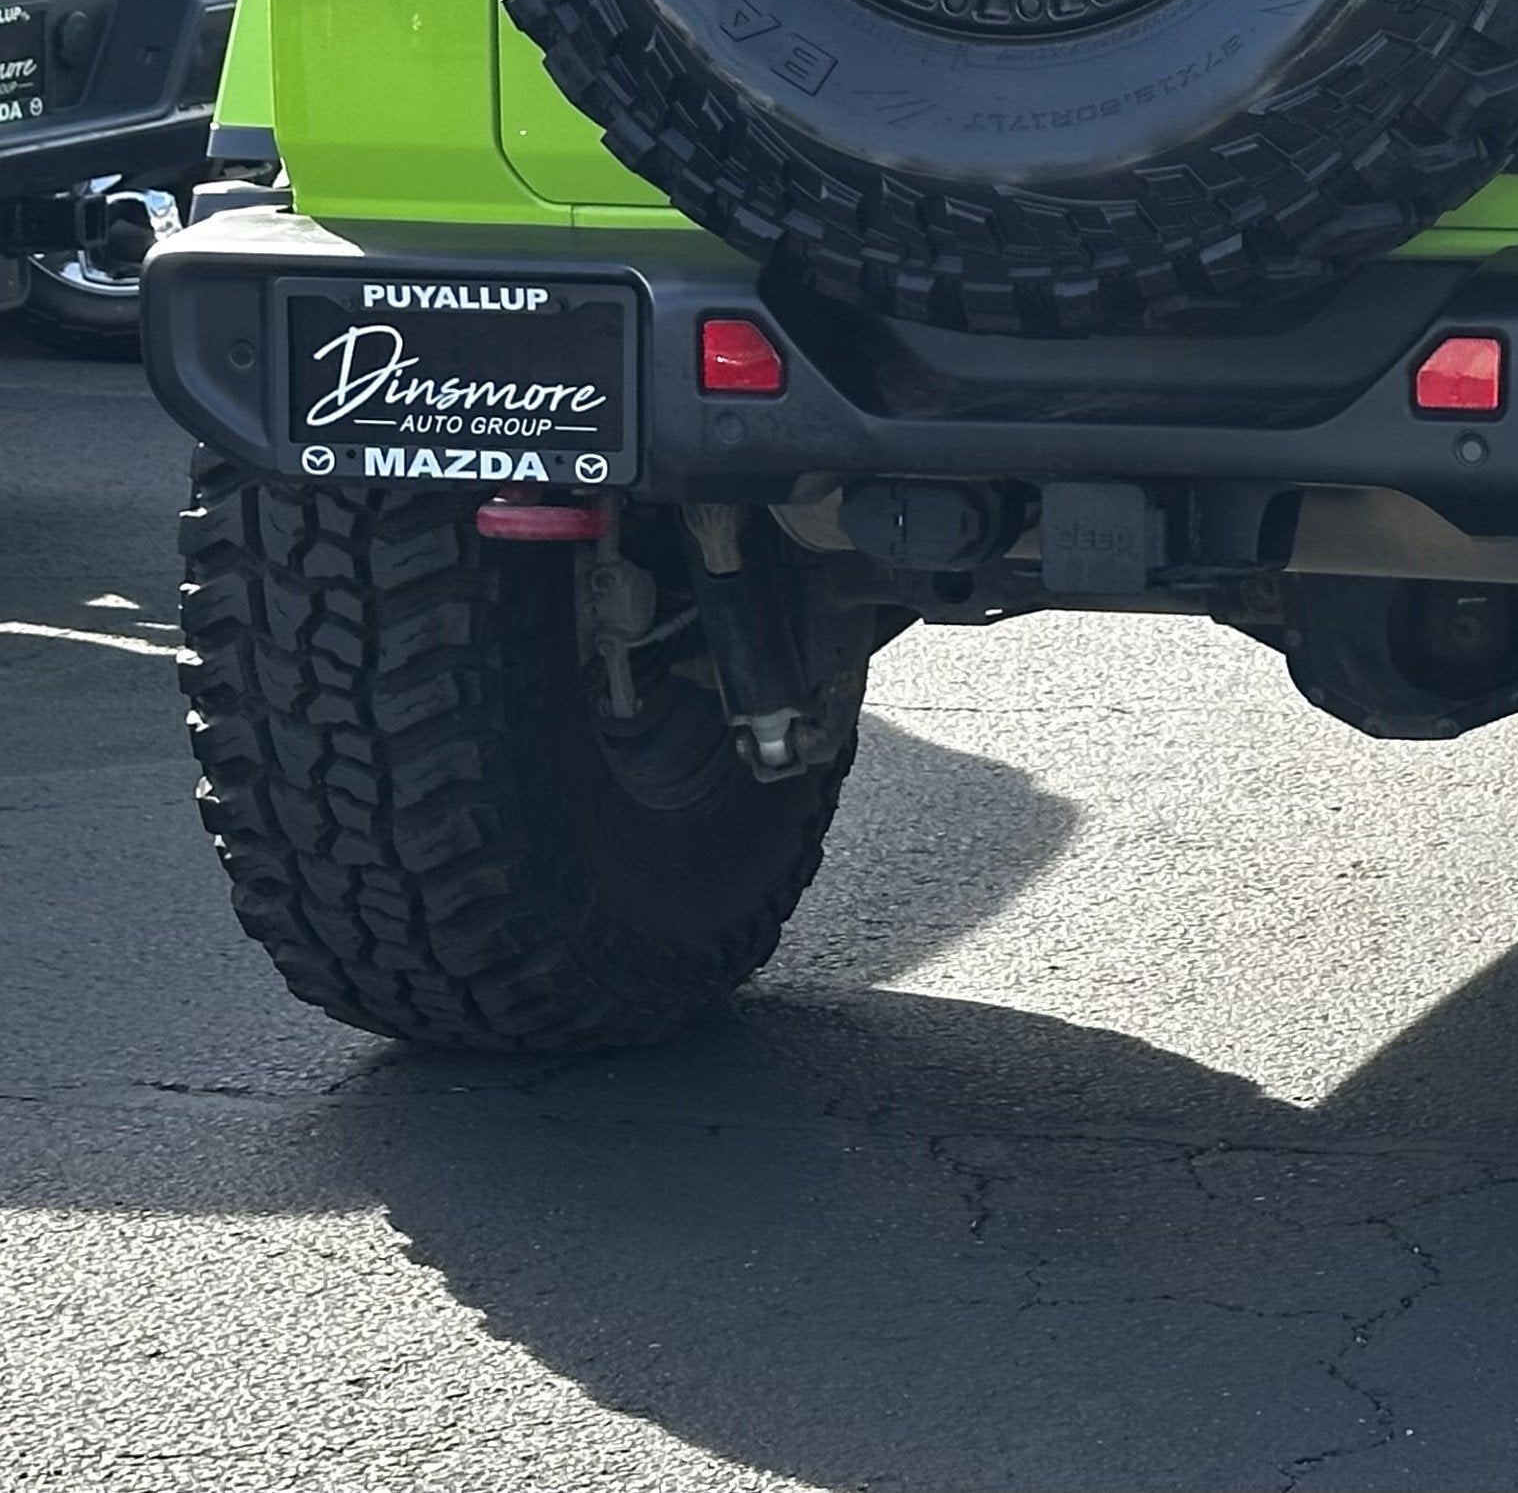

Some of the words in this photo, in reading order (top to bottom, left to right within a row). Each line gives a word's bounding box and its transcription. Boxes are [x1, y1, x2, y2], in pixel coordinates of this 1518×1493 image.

[363, 283, 549, 311] PUYALLUP
[306, 324, 607, 427] Dinsmore
[399, 414, 463, 434] AUTO
[470, 415, 553, 437] GROUP
[363, 447, 550, 482] MAZDA
